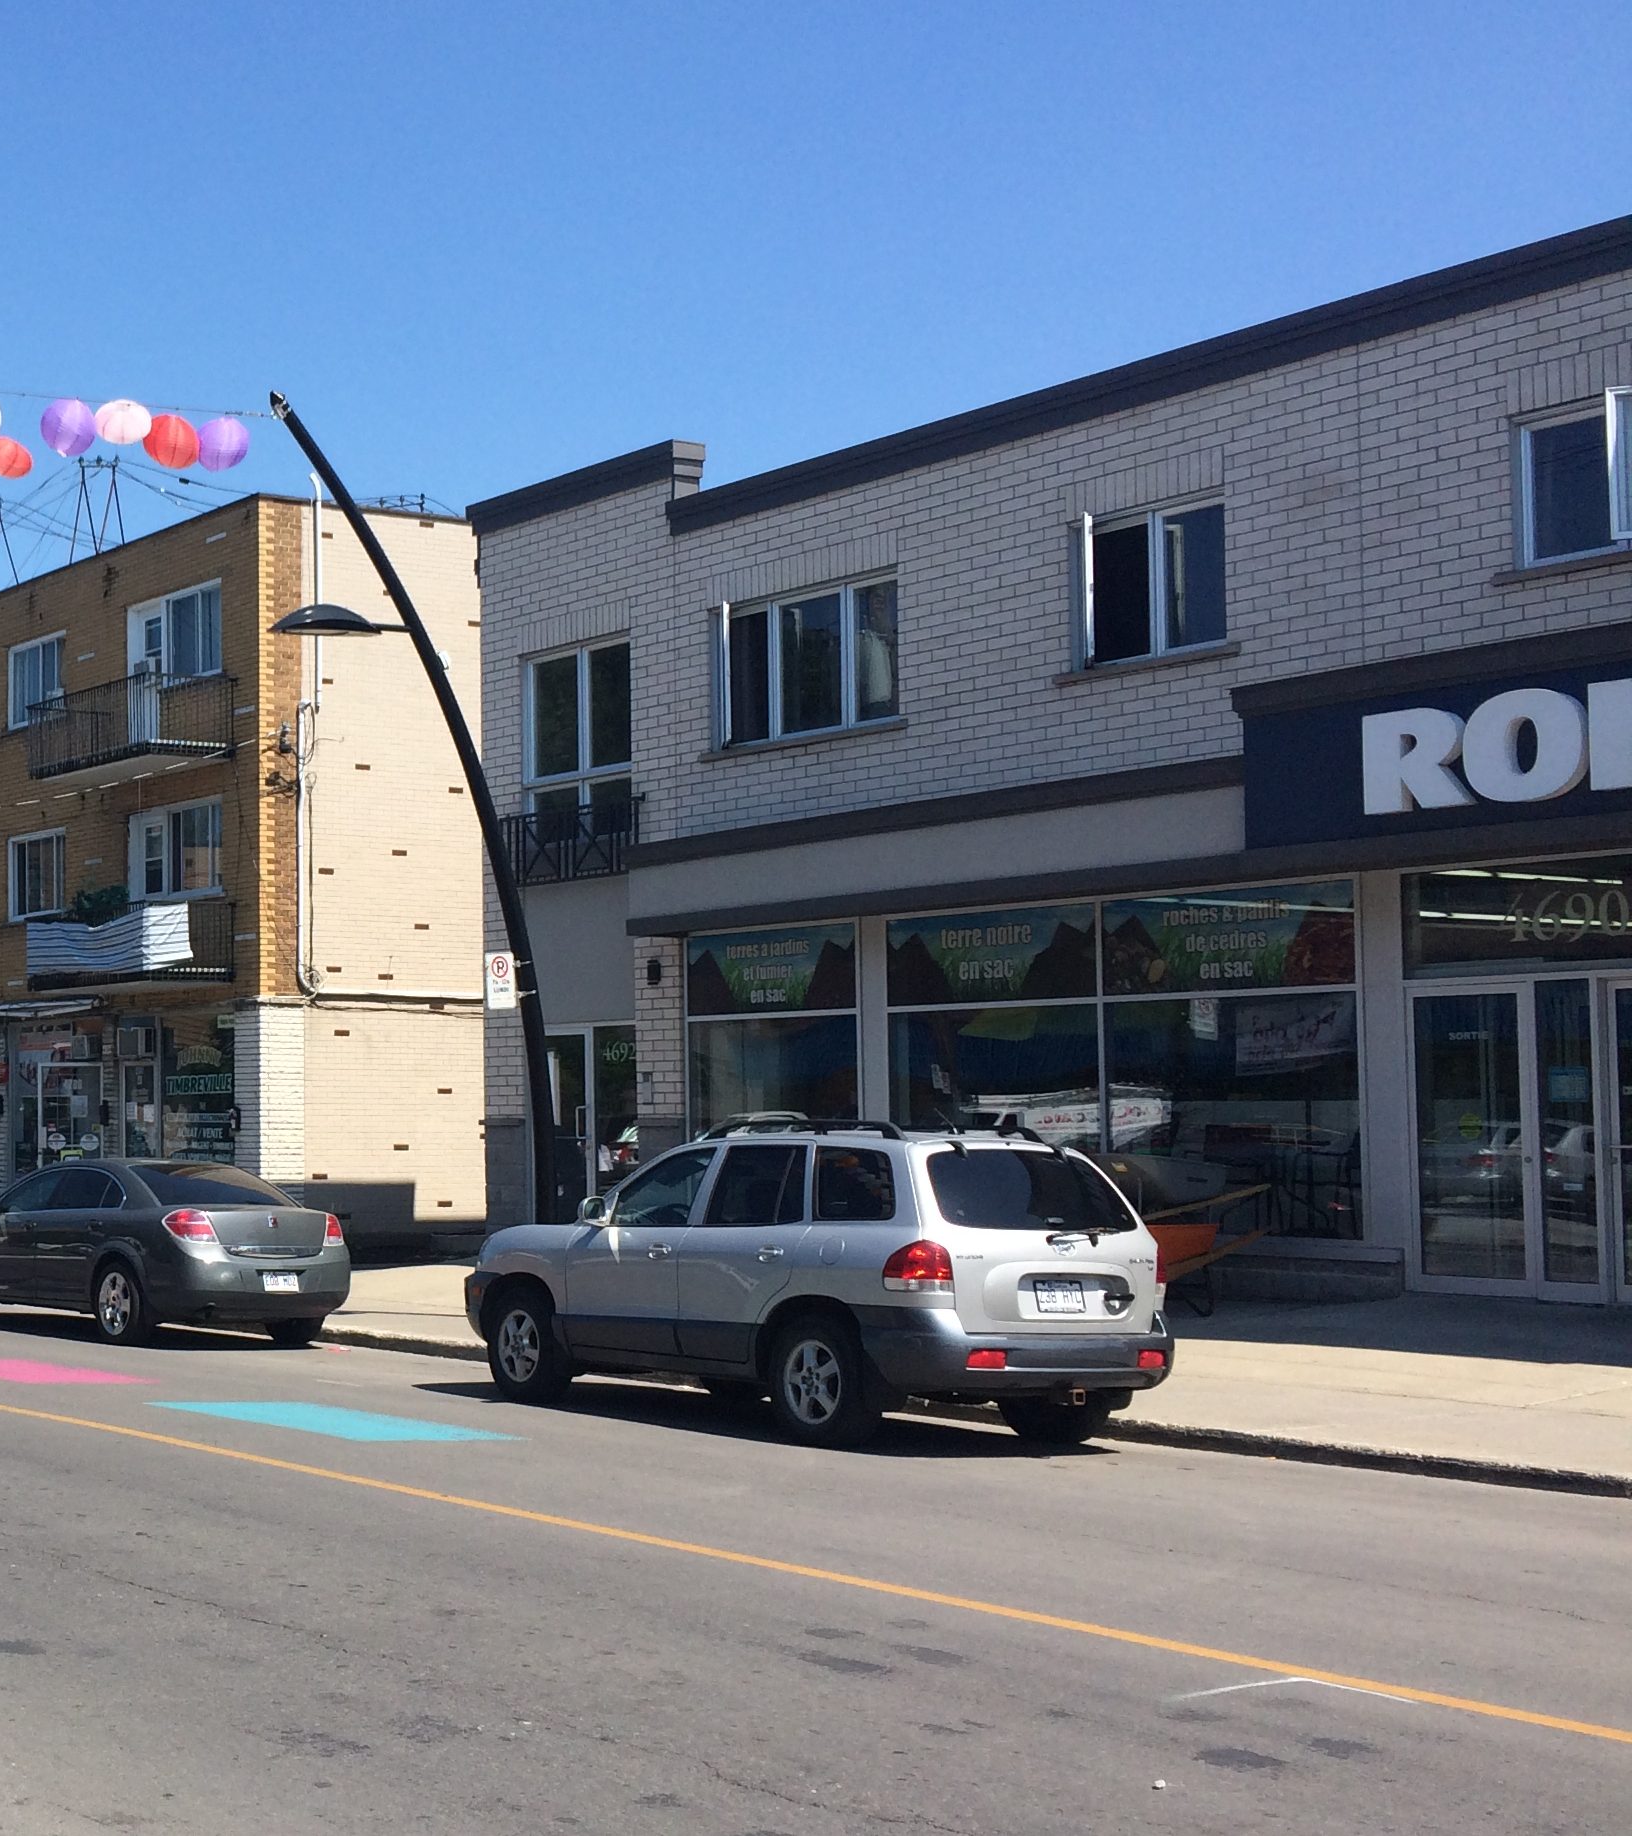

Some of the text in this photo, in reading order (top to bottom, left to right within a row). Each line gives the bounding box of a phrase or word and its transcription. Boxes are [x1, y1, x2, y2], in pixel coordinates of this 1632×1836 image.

[1162, 906, 1218, 926] roches
[1221, 905, 1234, 921] &
[1499, 889, 1630, 943] 4690
[941, 923, 1032, 949] terre noire
[1185, 933, 1207, 952] de
[726, 944, 759, 960] terres
[770, 938, 810, 957] jardins
[743, 964, 792, 981] et fumier
[959, 959, 1014, 980] en sac
[1199, 960, 1253, 980] en sac
[750, 988, 786, 1004] en sac
[1448, 1031, 1490, 1041] SORTIE
[601, 1041, 636, 1062] 4692
[166, 1073, 233, 1096] TIMBREVILLE
